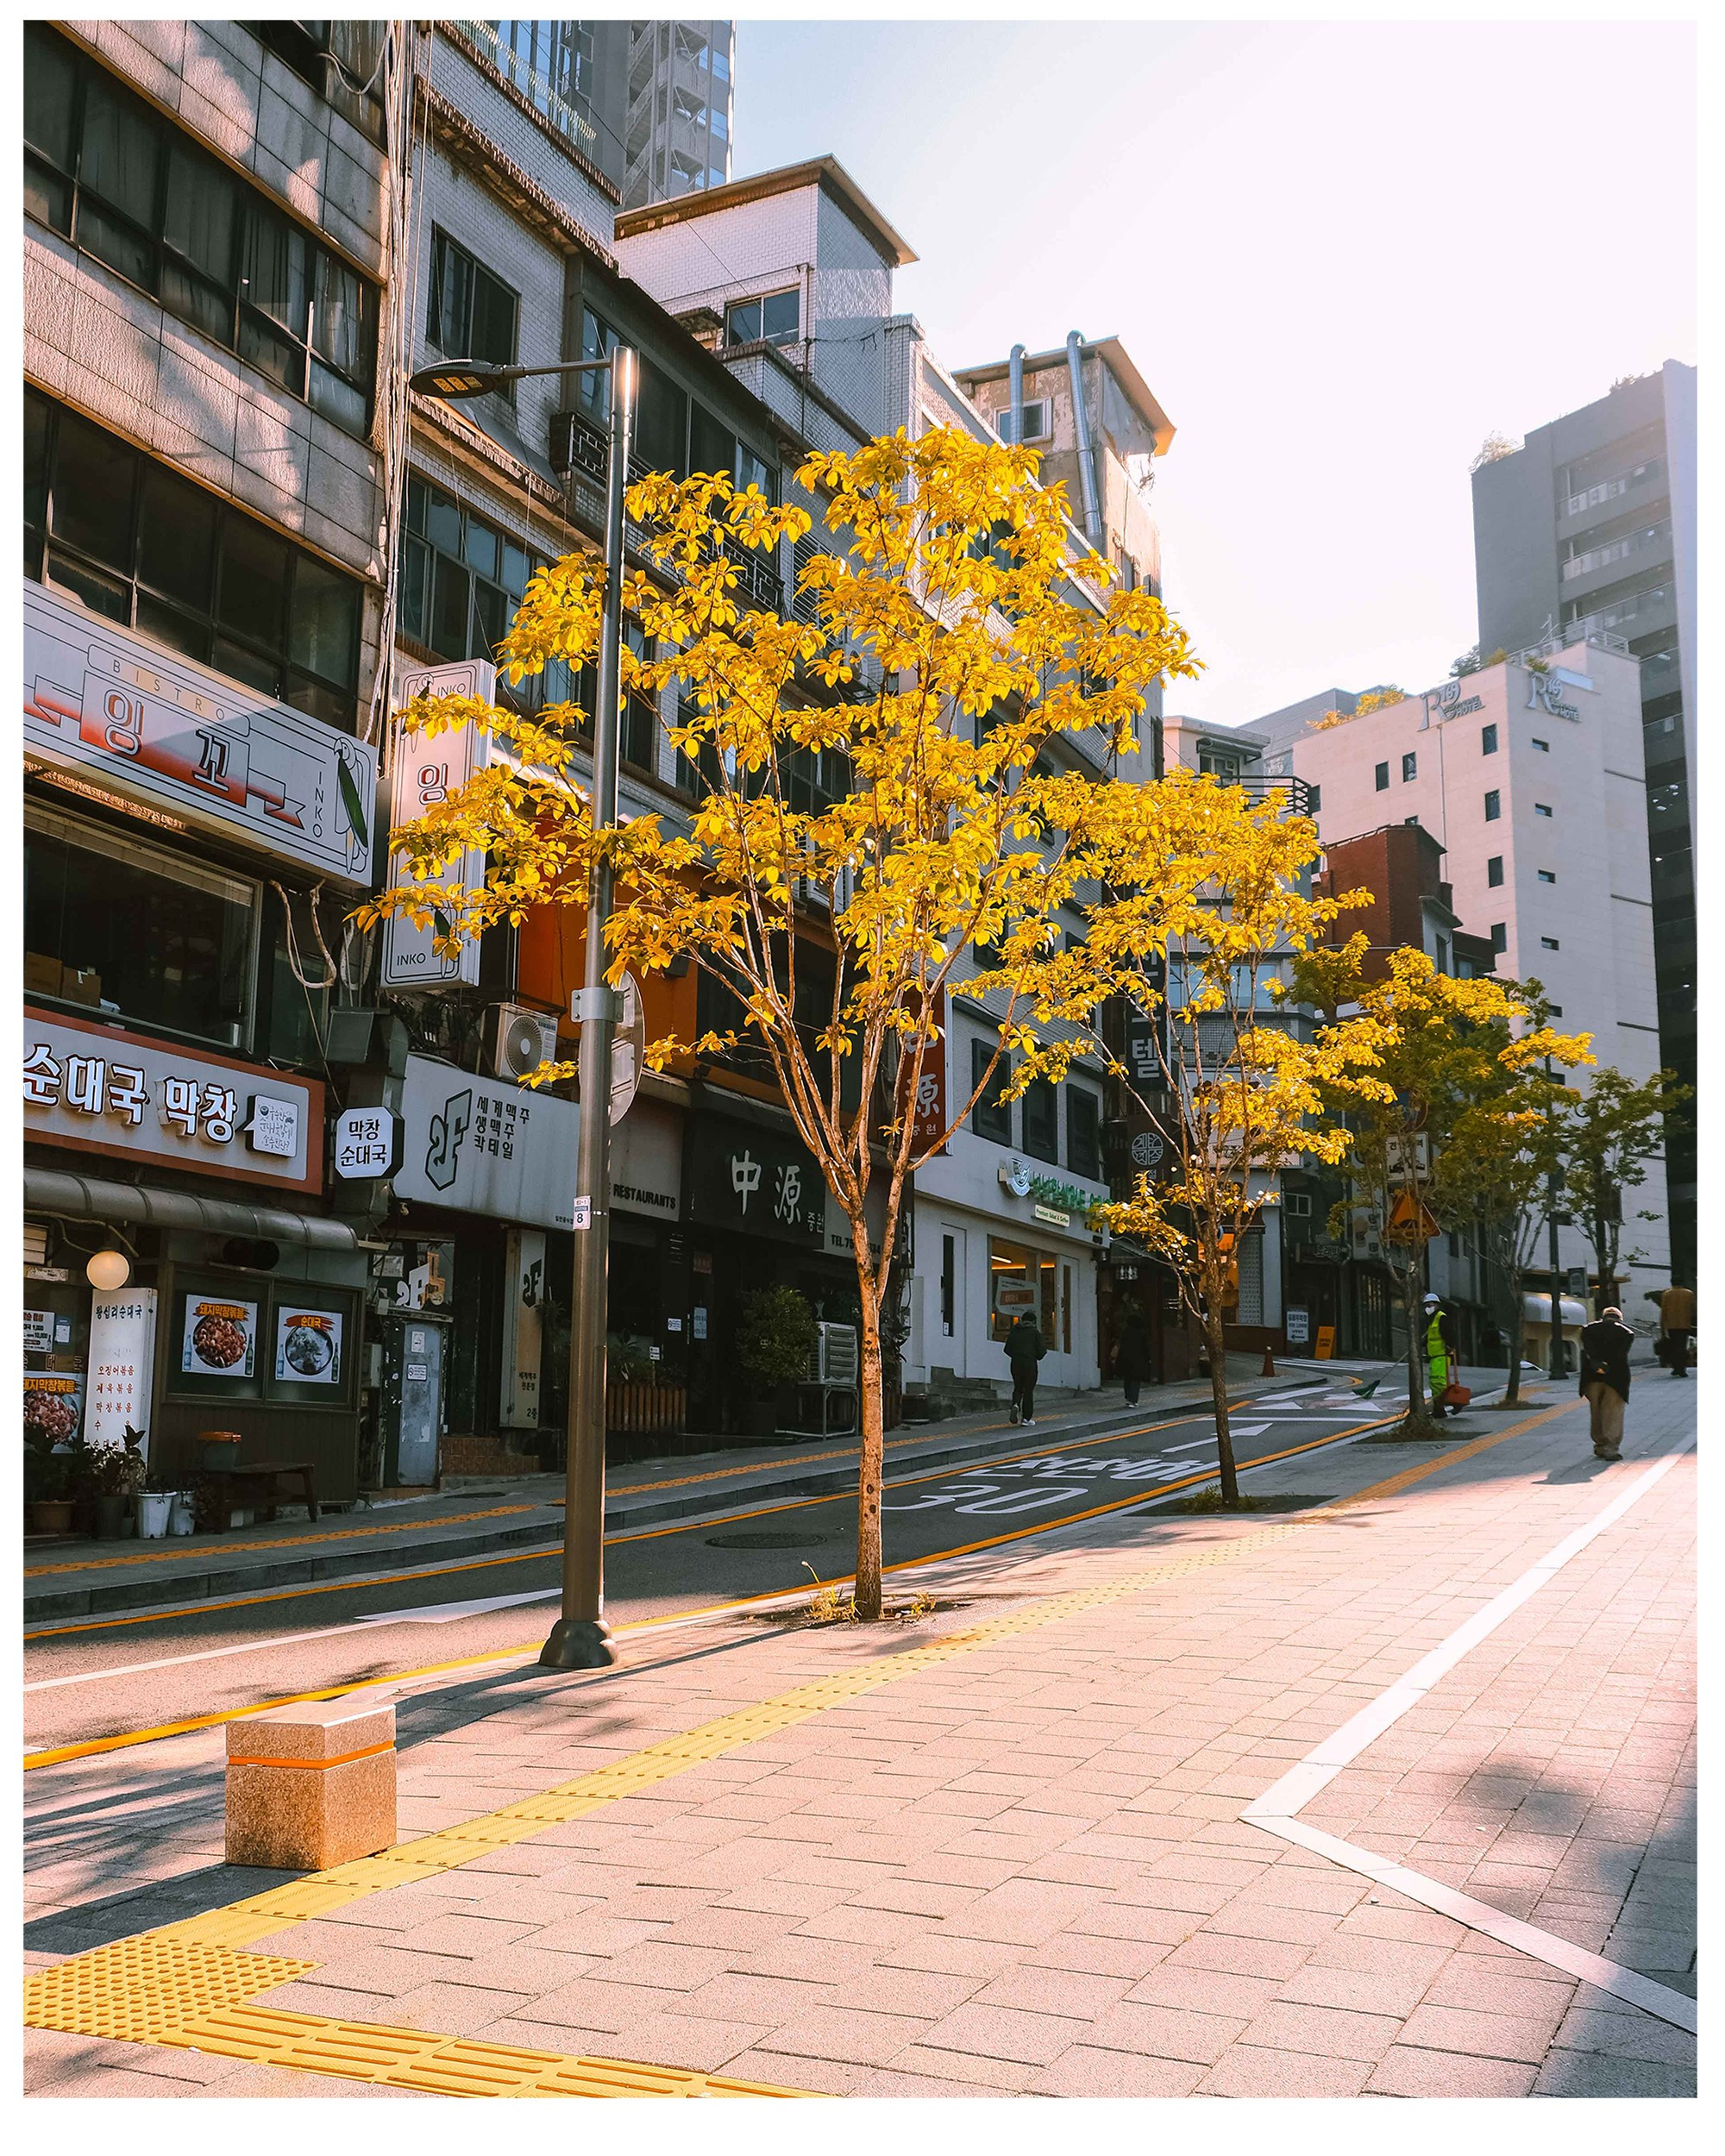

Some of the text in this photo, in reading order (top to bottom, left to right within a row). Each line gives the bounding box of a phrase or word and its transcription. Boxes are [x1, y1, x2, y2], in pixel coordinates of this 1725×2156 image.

[112, 660, 226, 720] BISTRO
[436, 682, 467, 697] INKO
[103, 689, 233, 793] 잉꼬
[313, 770, 325, 839] INKO
[397, 952, 426, 967] INKO
[23, 1043, 239, 1145] 순대국 막창
[476, 1095, 530, 1125] 세계맥주
[348, 1119, 380, 1142] 막창
[475, 1114, 515, 1140] 생맥주
[339, 1144, 387, 1168] 순대국
[474, 1134, 514, 1160] 칵테일
[613, 1183, 677, 1210] RESTAURANTS
[731, 1150, 802, 1225] 中源
[576, 1213, 584, 1224] 8
[807, 1211, 825, 1233] 중원
[95, 1305, 143, 1320] 왕십리순대국
[198, 1302, 246, 1319] 돼지막창볶음
[300, 1316, 322, 1329] 순대국
[97, 1365, 135, 1376] 오징어볶음
[96, 1382, 134, 1395] 제육볶음
[881, 1485, 1088, 1514] 30
